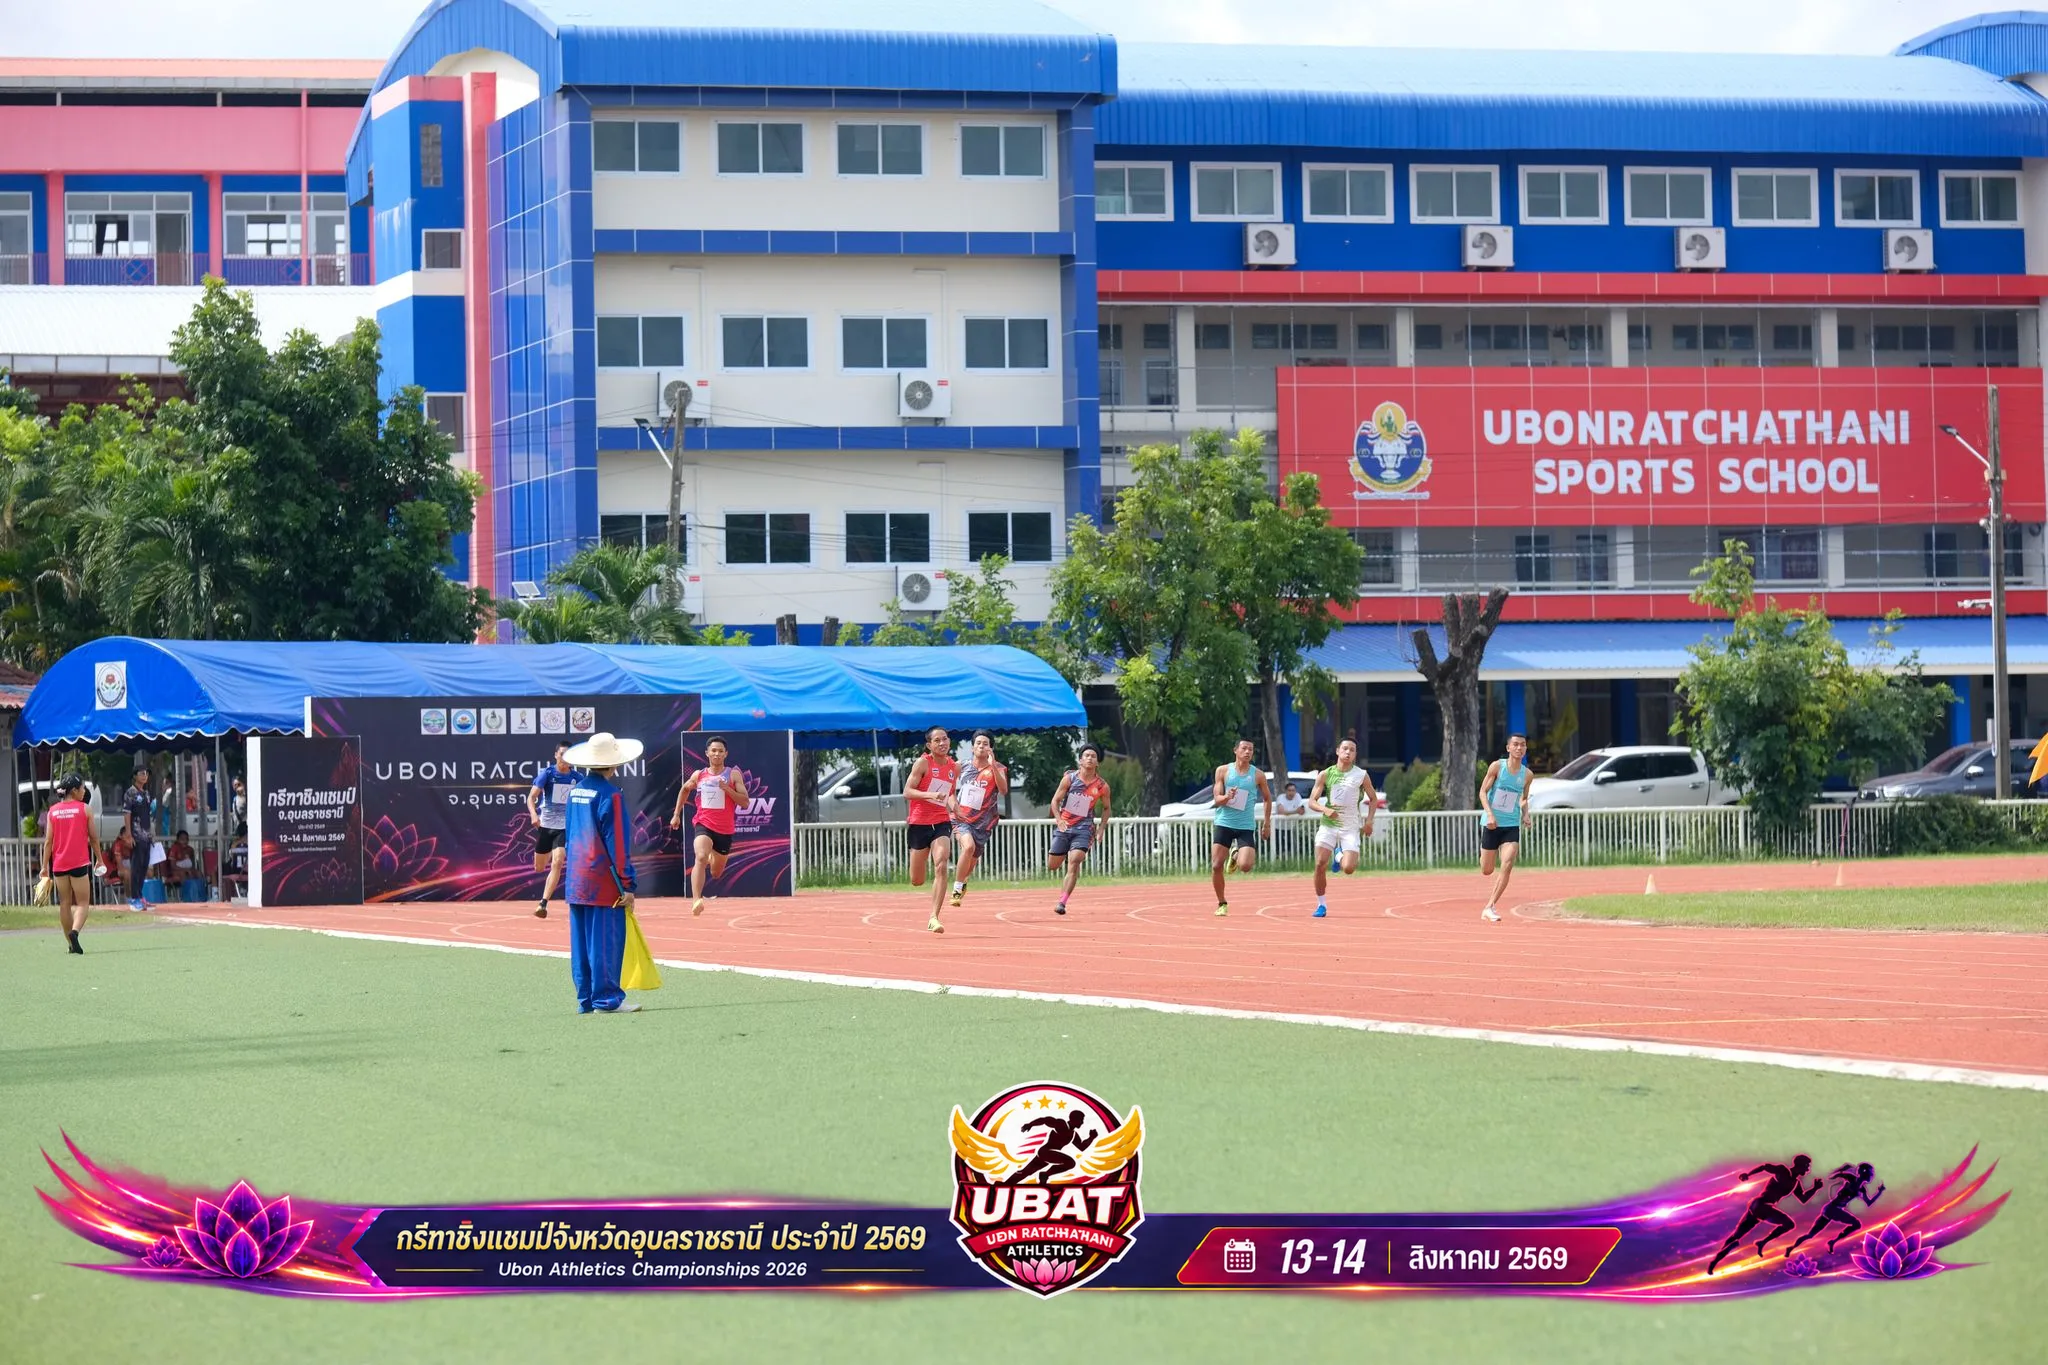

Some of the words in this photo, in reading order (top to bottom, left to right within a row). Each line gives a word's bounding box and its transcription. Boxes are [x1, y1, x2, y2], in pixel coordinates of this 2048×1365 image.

[1483, 409, 1911, 446] UBONRATCHATHANI
[1533, 458, 1695, 495] SPORTS
[1718, 457, 1879, 494] SCHOOL
[375, 761, 457, 781] UBON
[706, 791, 717, 806] 7
[1334, 788, 1345, 800] 2
[1498, 793, 1508, 808] 1
[328, 833, 346, 841] 2569
